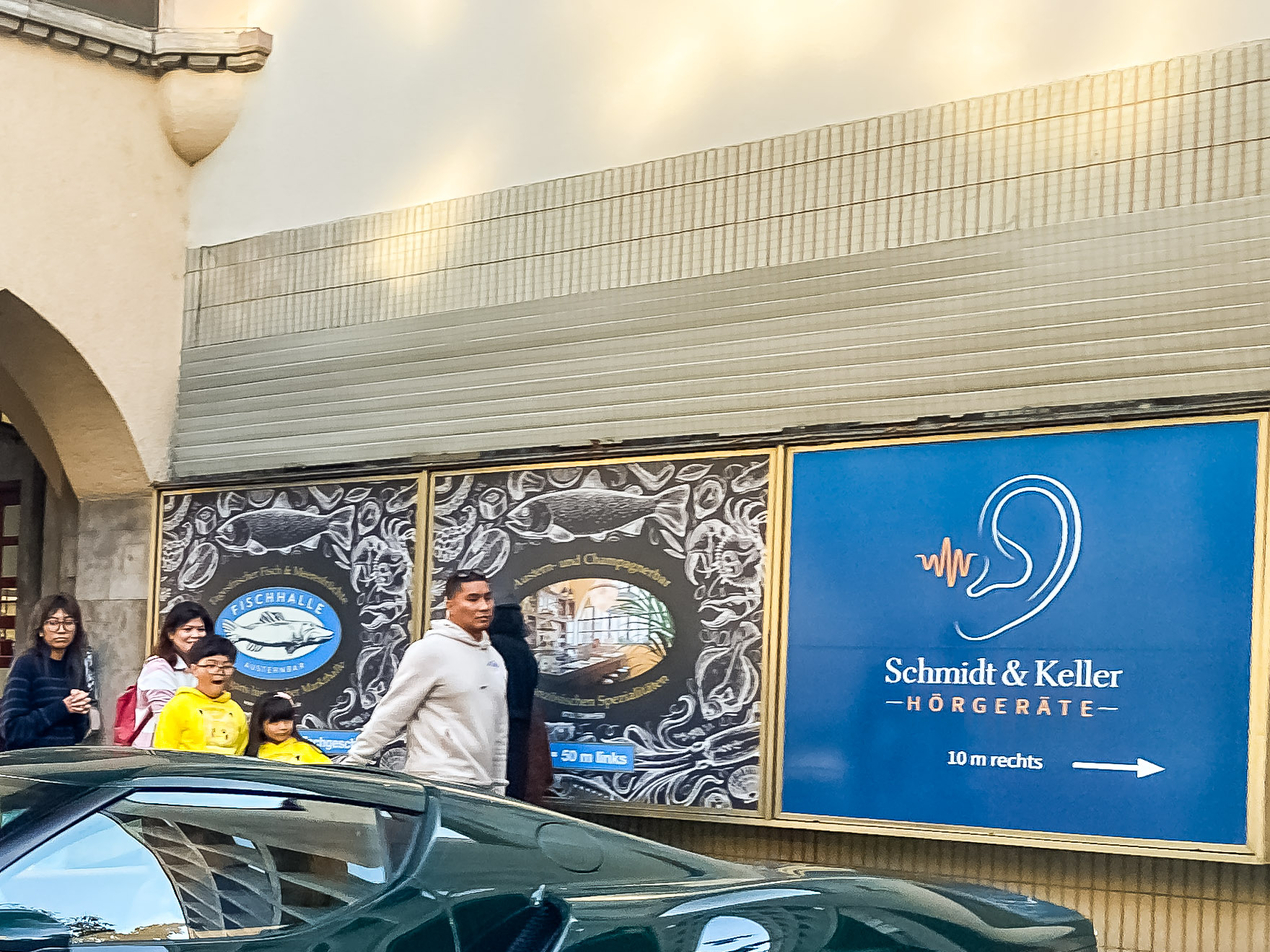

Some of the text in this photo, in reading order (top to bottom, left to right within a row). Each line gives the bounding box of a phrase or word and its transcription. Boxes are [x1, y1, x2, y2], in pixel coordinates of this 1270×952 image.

[230, 592, 325, 616] FISCHHALLE
[244, 662, 305, 674] AUSTERNBAR
[884, 656, 1124, 688] Schmidt & Keller
[906, 692, 1094, 718] HÖRGERÄTE
[561, 749, 577, 762] 50
[580, 752, 593, 763] m
[595, 751, 628, 765] links
[947, 750, 1044, 770] 10 m rechts
